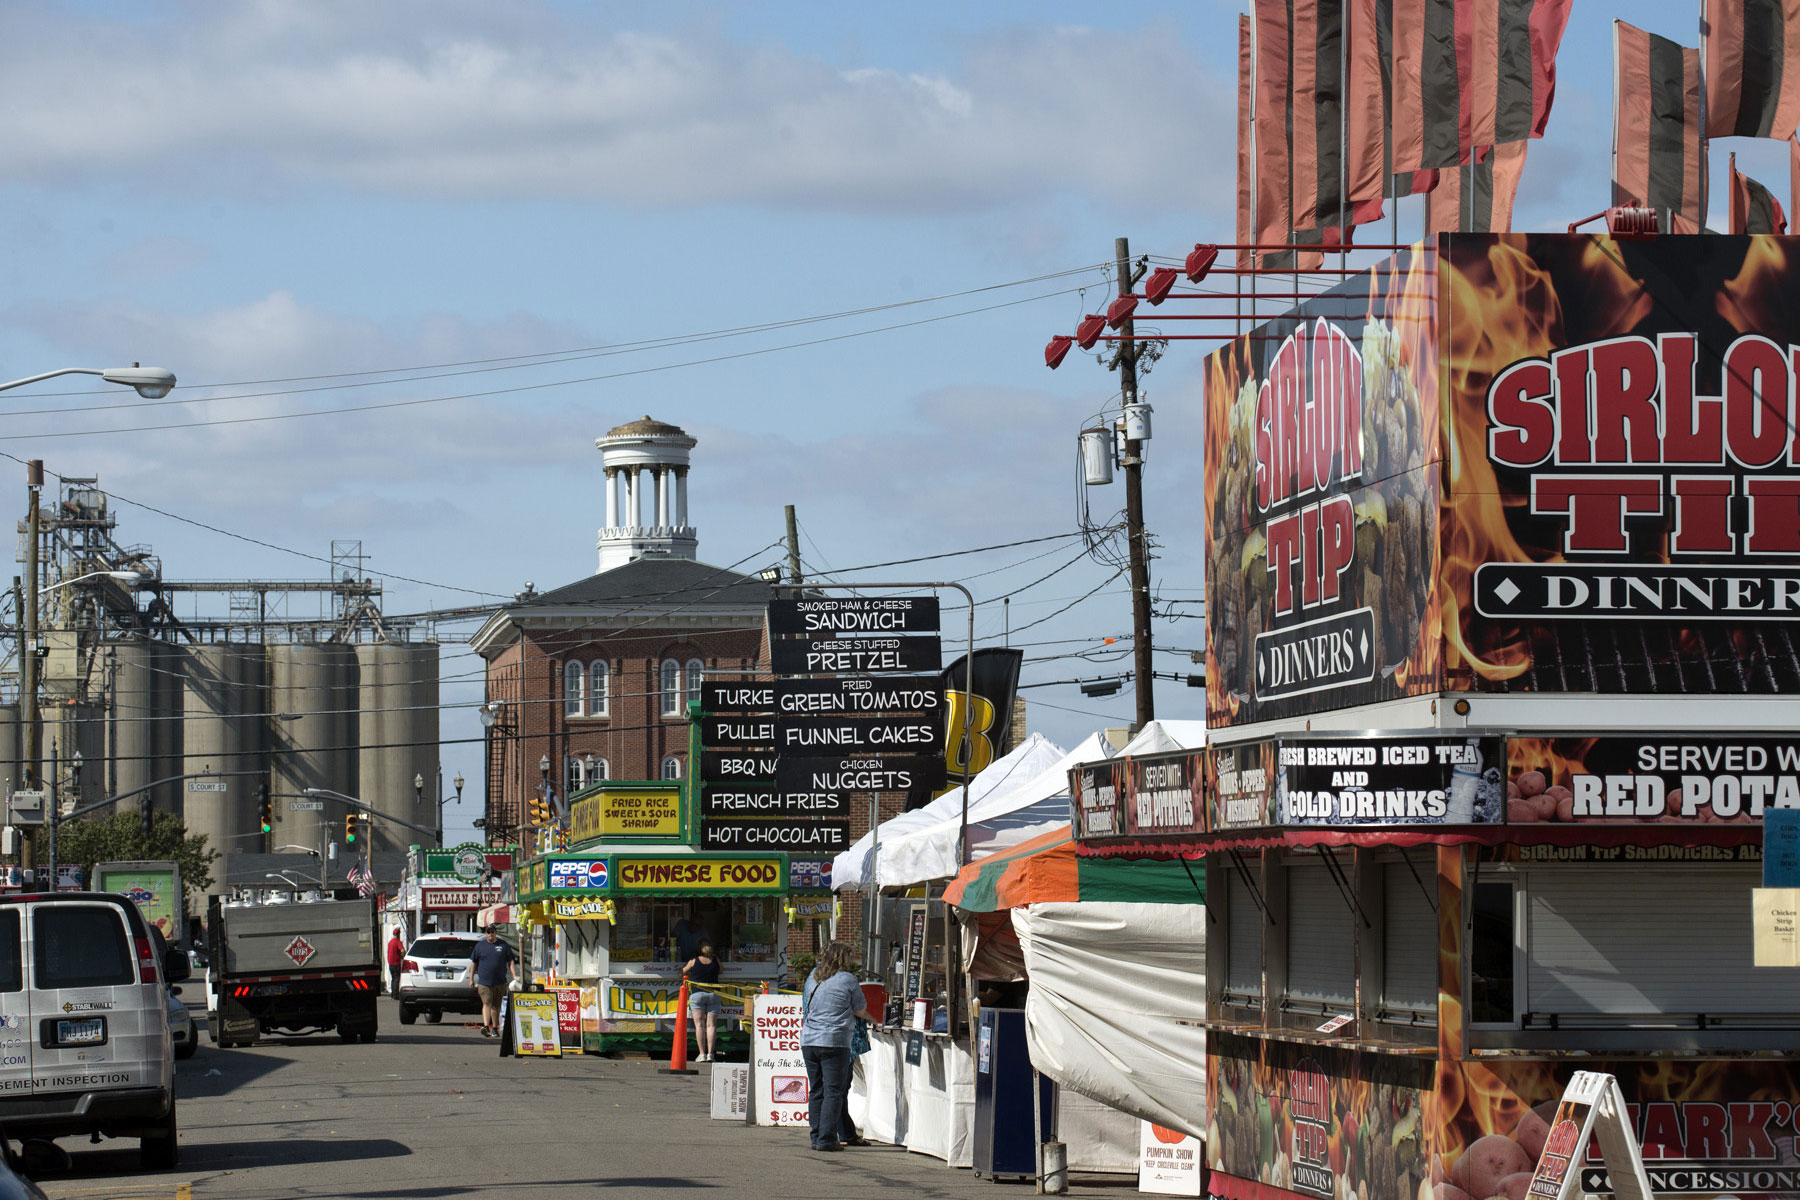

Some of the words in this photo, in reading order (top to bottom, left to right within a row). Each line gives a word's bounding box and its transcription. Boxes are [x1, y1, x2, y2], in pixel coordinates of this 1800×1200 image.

[1255, 316, 1363, 513] SIRLOIN
[1266, 493, 1355, 618] TIP
[796, 601, 838, 612] SMOKED
[841, 600, 862, 610] HAM
[864, 601, 870, 610] &
[872, 600, 913, 610] CHEESE
[805, 612, 906, 631] SANDWICH
[811, 641, 852, 651] CHEESE
[854, 639, 900, 650] STUFFED
[806, 651, 907, 671] PRETZEL
[1270, 628, 1354, 688] DINNERS
[842, 680, 872, 690] FRIED
[714, 689, 774, 706] TURKE
[780, 692, 845, 711] GREEN
[849, 690, 938, 711] TOMATOS
[717, 724, 774, 740] PULLE
[786, 728, 864, 746] FUNNEL
[869, 726, 934, 743] CAKES
[1280, 748, 1304, 766] FRESH
[1307, 747, 1377, 766] BREWED
[1382, 746, 1430, 765] ICED
[1435, 745, 1478, 764] TEA
[1638, 745, 1767, 771] SERVED
[721, 758, 756, 777] BBQ
[840, 759, 883, 770] CHICKEN
[813, 771, 912, 791] NUGGETS
[1145, 765, 1166, 789] SERVED
[1166, 763, 1182, 787] WITH
[1331, 771, 1369, 787] AND
[611, 798, 642, 808] FRIED
[646, 798, 669, 808] RICE
[711, 793, 781, 810] FRENCH
[786, 792, 840, 809] FRIES
[1572, 775, 1666, 816] RED
[1681, 774, 1800, 817] POTA
[1136, 792, 1152, 828] RED
[1153, 789, 1194, 827] POTATOES
[1289, 791, 1333, 818] COLD
[1340, 790, 1448, 818] DRINKS
[605, 809, 640, 818] SWEET
[649, 809, 677, 818] SOUR
[621, 819, 659, 828] SHRIMP
[708, 828, 743, 844] HOT
[746, 827, 842, 844] CHOCOLATE
[1519, 844, 1587, 860] SIRLOIN
[1592, 844, 1621, 860] TIP
[1625, 844, 1734, 860] SANDWICHES
[1738, 844, 1763, 860] AL
[551, 862, 591, 875] PEPSI
[621, 864, 712, 884] CHINESE
[719, 864, 777, 884] FOOD
[790, 862, 821, 875] PEPSI
[429, 893, 468, 905] ITALIAN
[472, 893, 502, 905] SAUSA
[557, 903, 606, 916] LEMONADE
[612, 979, 644, 987] FRESH
[557, 993, 579, 1002] ERAL
[720, 1008, 745, 1016] NESE
[767, 1006, 795, 1015] HUGE
[756, 1017, 803, 1028] SMOK
[61, 1026, 78, 1038] PHJ
[79, 1024, 100, 1037] 1174
[758, 1029, 801, 1040] TURK
[769, 1041, 801, 1051] LEG
[1, 1055, 26, 1067] .COM
[757, 1058, 775, 1070] Only
[777, 1058, 792, 1068] The
[793, 1058, 806, 1068] Be
[52, 1073, 130, 1088] INSPECTION
[739, 1069, 748, 1095] PUMPKIN
[1291, 1057, 1330, 1124] SIRLOIN
[1586, 1101, 1800, 1161] ARK'
[1295, 1120, 1327, 1164] TIP
[1146, 1147, 1174, 1159] PUMPKIN
[1176, 1149, 1194, 1160] SHOW
[1540, 1155, 1567, 1180] TIP
[1297, 1166, 1327, 1190] DINNERS
[1604, 1171, 1800, 1190] NCESSION
[1534, 1181, 1557, 1195] DINNERS
